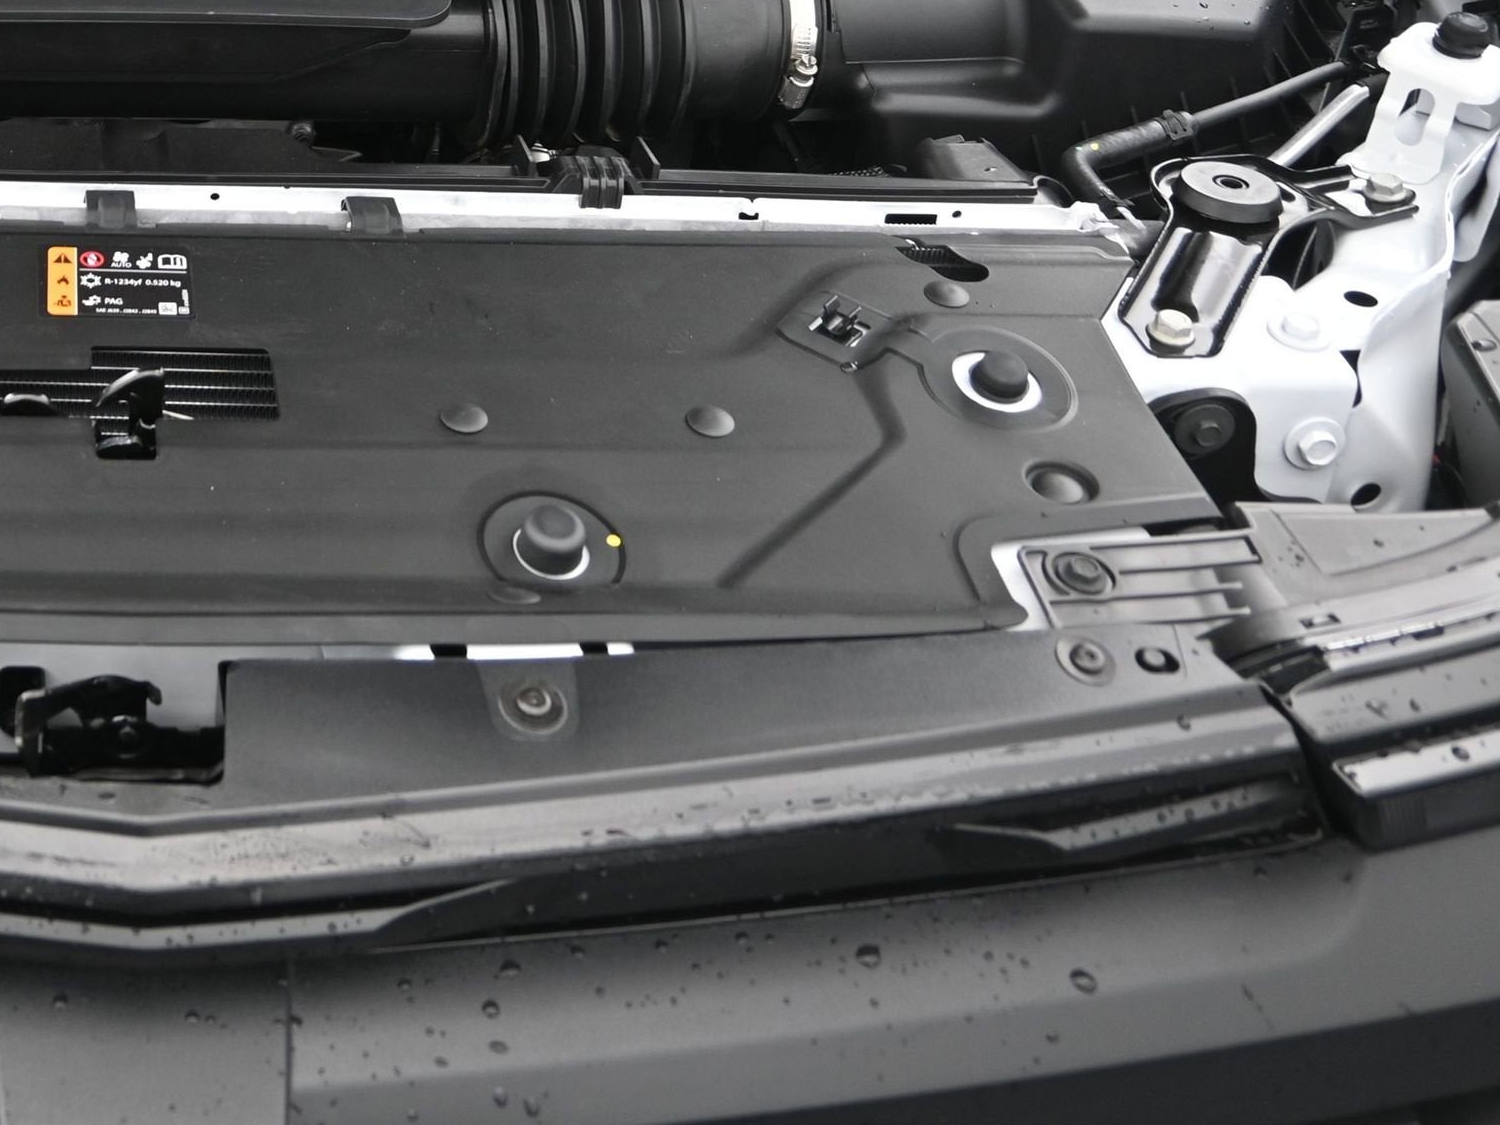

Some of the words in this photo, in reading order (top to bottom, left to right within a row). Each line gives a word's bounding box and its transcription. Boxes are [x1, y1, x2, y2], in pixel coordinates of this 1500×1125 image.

[104, 278, 142, 287] R-1234yf
[170, 279, 181, 288] kg
[104, 297, 123, 305] PAG
